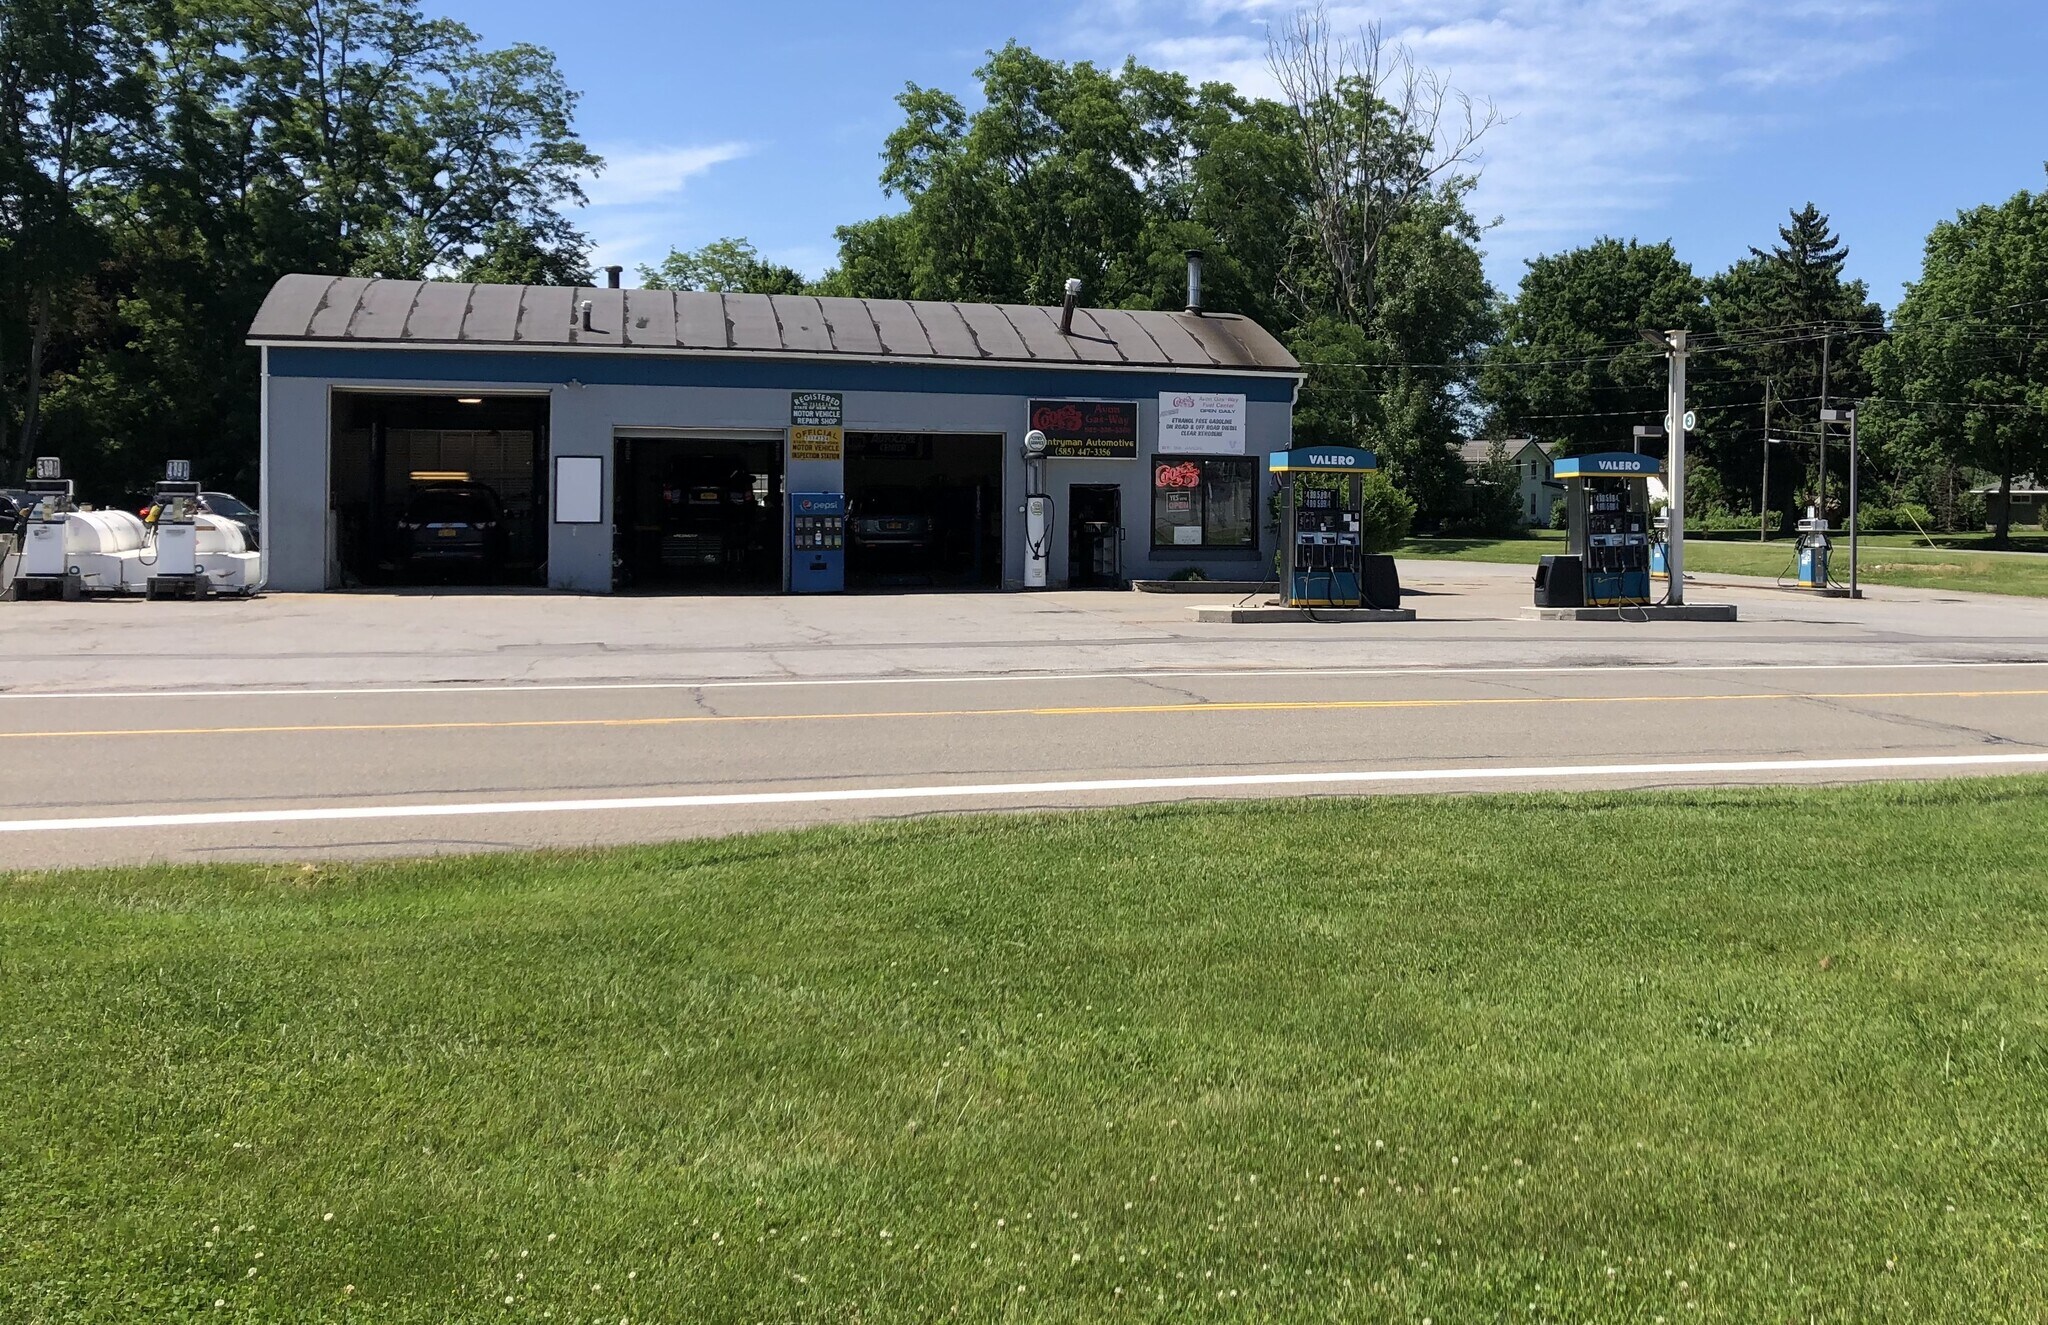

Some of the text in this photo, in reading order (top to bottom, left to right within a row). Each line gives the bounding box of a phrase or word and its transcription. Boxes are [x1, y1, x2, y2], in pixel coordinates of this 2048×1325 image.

[793, 393, 840, 406] REGISTERED
[1095, 404, 1120, 413] Avon
[815, 410, 841, 418] VEHICLE
[797, 417, 820, 425] REPAIR
[795, 429, 838, 440] OFFICIAL
[1046, 438, 1134, 447] ntryman Automotive
[815, 444, 840, 452] VEHICLE
[1054, 447, 1111, 456] (585) 447-3356
[820, 452, 840, 460] STATION
[1309, 455, 1355, 465] VALERO
[1598, 460, 1641, 471] VALERO
[813, 501, 838, 510] pepsi
[1168, 501, 1189, 510] OPEN
